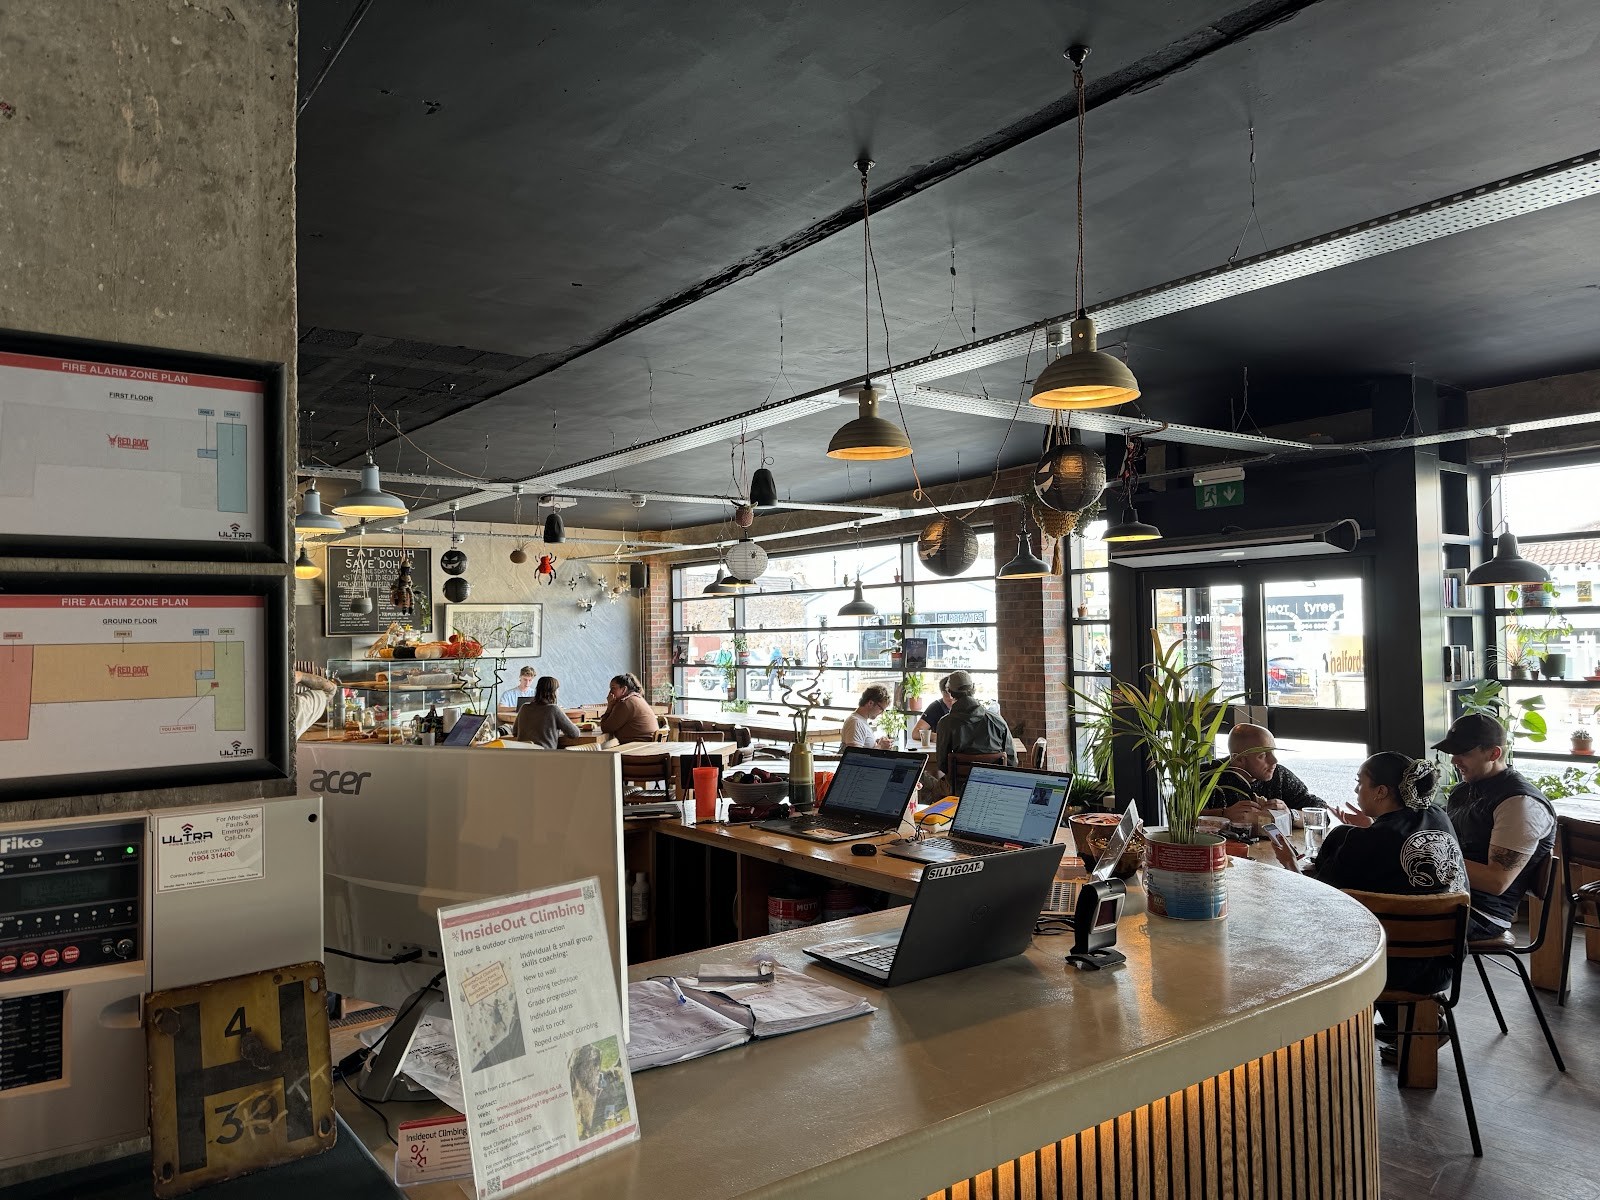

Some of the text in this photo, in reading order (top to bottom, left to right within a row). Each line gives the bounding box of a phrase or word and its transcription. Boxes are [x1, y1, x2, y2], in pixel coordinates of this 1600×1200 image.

[61, 361, 188, 384] FIRE ALARM ZONE PLAN
[109, 392, 154, 402] FIRST FLOOR
[118, 436, 131, 446] RED
[132, 438, 149, 448] GOAT
[218, 531, 252, 539] ULTRA
[346, 548, 374, 558] EAT
[346, 559, 374, 568] SAVE
[61, 598, 189, 607] FIRE ALARM ZONE PLAN
[1268, 602, 1336, 616] MOT tyres
[117, 665, 149, 675] RED GOAT
[220, 748, 253, 756] ULTRA
[310, 769, 372, 796] acer
[227, 813, 259, 821] After-Sales
[162, 830, 213, 844] ULTRA
[221, 826, 254, 836] Emergency
[224, 834, 251, 842] Call-Outs
[1412, 836, 1426, 848] RED
[0, 836, 44, 854] Fike
[188, 851, 235, 862] 01904 314400
[928, 862, 980, 879] SILLYGOAT
[796, 902, 818, 912] MUTT
[460, 915, 527, 942] InsideOut
[529, 903, 586, 924] Climbing
[453, 946, 474, 958] Indoor
[482, 939, 507, 951] outdoor
[508, 931, 534, 944] climbing
[534, 924, 566, 937] instruction
[520, 945, 552, 960] Individual
[559, 939, 575, 949] small
[576, 934, 594, 946] group
[521, 950, 569, 969] skills coaching:
[523, 974, 537, 983] New
[545, 967, 557, 976] wall
[525, 974, 579, 995] Climbing technique
[527, 988, 578, 1008] Grade progression
[529, 1003, 574, 1022] Individual plans
[224, 1006, 252, 1038] 4
[531, 1024, 545, 1034] Wall
[554, 1019, 566, 1028] rock
[534, 1021, 599, 1048] Roped outdoor climbing
[476, 1100, 497, 1110] Contact:
[478, 1111, 491, 1119] Web:
[479, 1119, 495, 1128] Email:
[406, 1128, 468, 1142] Insideout Climbing
[480, 1128, 498, 1138] Phone:
